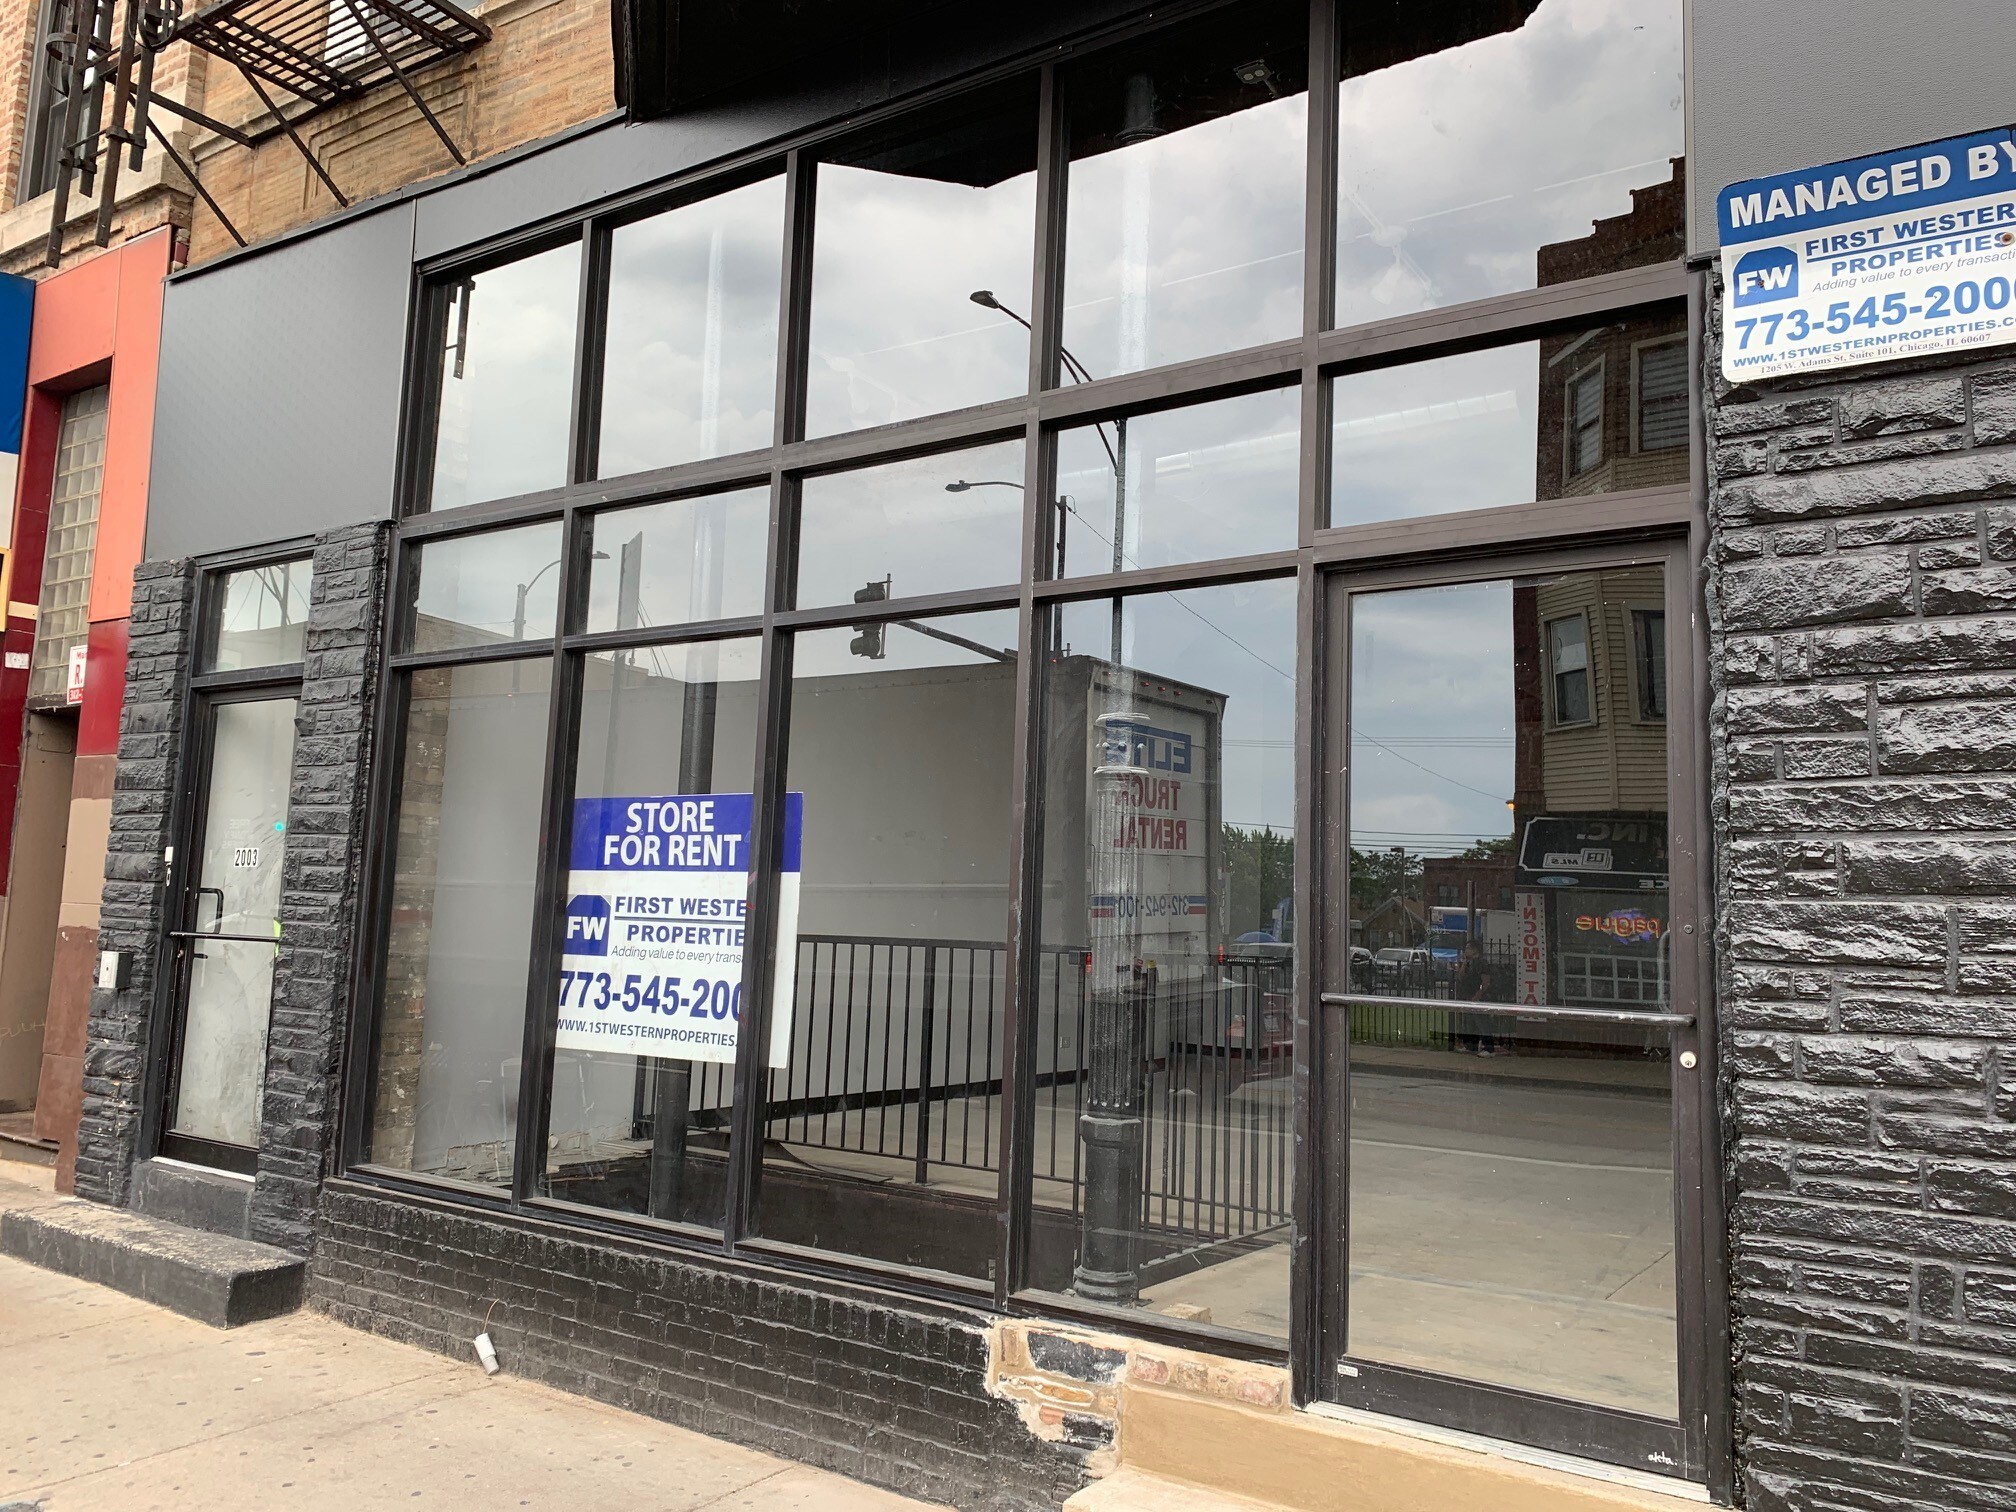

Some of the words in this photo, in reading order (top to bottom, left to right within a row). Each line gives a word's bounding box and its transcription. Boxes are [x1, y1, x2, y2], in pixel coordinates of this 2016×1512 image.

[1729, 154, 1951, 229] MANAGED
[1968, 140, 2016, 181] BY
[1805, 226, 1884, 257] FIRST
[1893, 202, 2016, 237] WESTER
[1737, 264, 1792, 297] FW
[1812, 277, 1857, 293] Adding
[1861, 270, 1895, 285] value
[1899, 267, 1912, 278] to
[1916, 260, 1953, 275] every
[1734, 276, 2016, 350] 773-545-200
[1761, 364, 1782, 374] 1205
[1798, 357, 1832, 368] Adams
[1833, 354, 1847, 362] St,
[1849, 350, 1874, 361] Suite
[1877, 347, 1897, 356] 101,
[1899, 341, 1944, 353] Chicago,
[1946, 338, 1959, 347] IL
[1961, 333, 1992, 345] 60607
[625, 801, 714, 833] STORE
[234, 849, 258, 867] 2003
[603, 835, 661, 866] FOR
[668, 834, 742, 867] RENT
[614, 896, 673, 915] FIRST
[680, 898, 746, 917] WESTE
[566, 916, 607, 941] FW
[626, 924, 744, 947] PROPERTIE
[611, 945, 647, 962] Adding
[648, 947, 674, 961] value
[675, 950, 686, 961] to
[686, 952, 715, 965] every
[715, 951, 743, 964] trans
